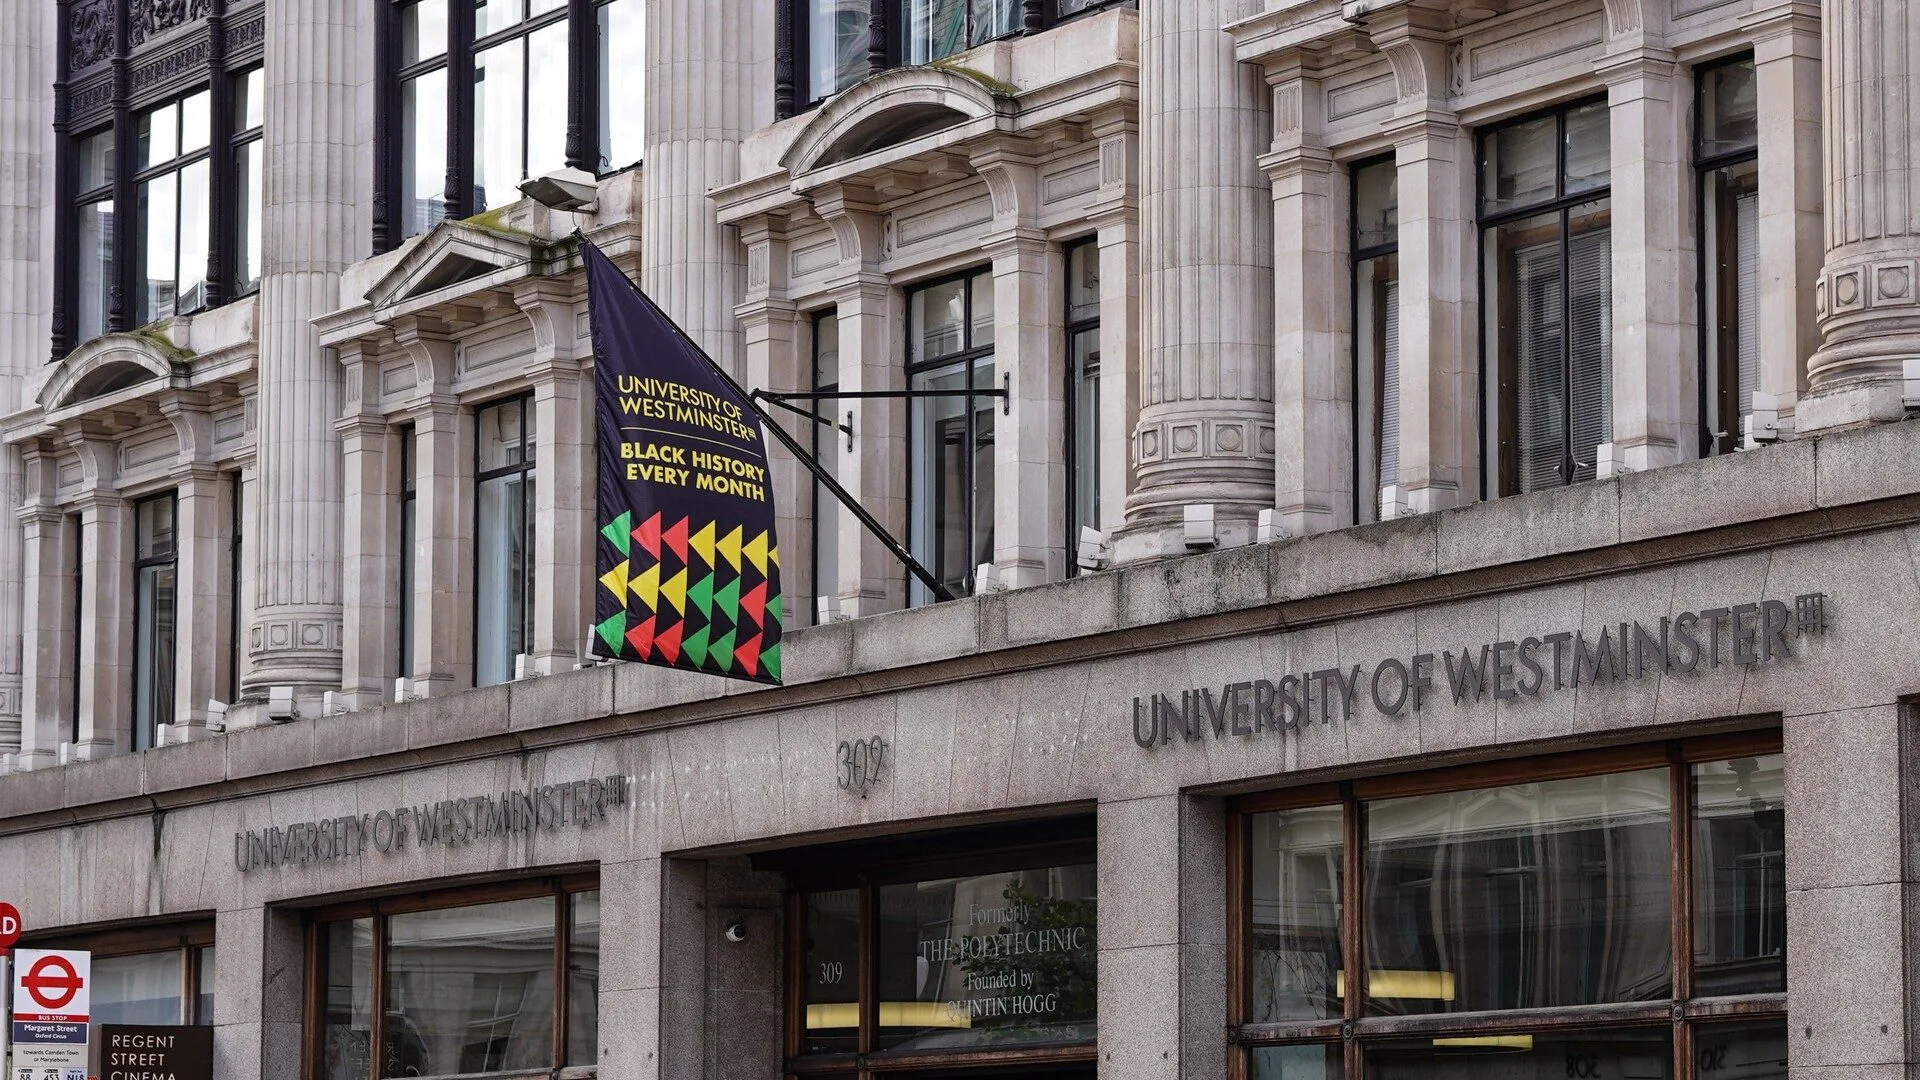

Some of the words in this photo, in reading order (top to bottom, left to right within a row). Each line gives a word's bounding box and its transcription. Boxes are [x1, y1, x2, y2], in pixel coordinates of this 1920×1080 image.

[618, 376, 721, 410] UNIVERSITY
[723, 400, 742, 420] OF
[619, 396, 749, 441] WESTMINSTER
[620, 442, 686, 466] BLACK
[692, 450, 764, 483] HISTORY
[626, 463, 690, 486] EVERY
[696, 472, 764, 502] MONTH
[1133, 663, 1361, 749] UNIVERSITY
[1371, 653, 1434, 716] OF
[1443, 600, 1792, 706] WESTMINSTER
[837, 735, 883, 790] 309
[234, 813, 368, 873] UNIVERSITY
[373, 807, 408, 853] OF
[412, 777, 605, 848] WESTMINSTER
[968, 902, 1031, 926] Formerly
[919, 938, 953, 963] THE
[960, 926, 1086, 960] POLYTECHNIC
[819, 961, 843, 985] 309
[967, 971, 1017, 991] Founded
[1020, 969, 1035, 991] by
[947, 996, 1008, 1023] QUINTIN
[1012, 993, 1057, 1016] HOGG
[24, 1024, 54, 1032] Margaret
[112, 1034, 175, 1048] REGENT
[111, 1053, 164, 1066] STREET
[111, 1071, 176, 1080] CINEMA
